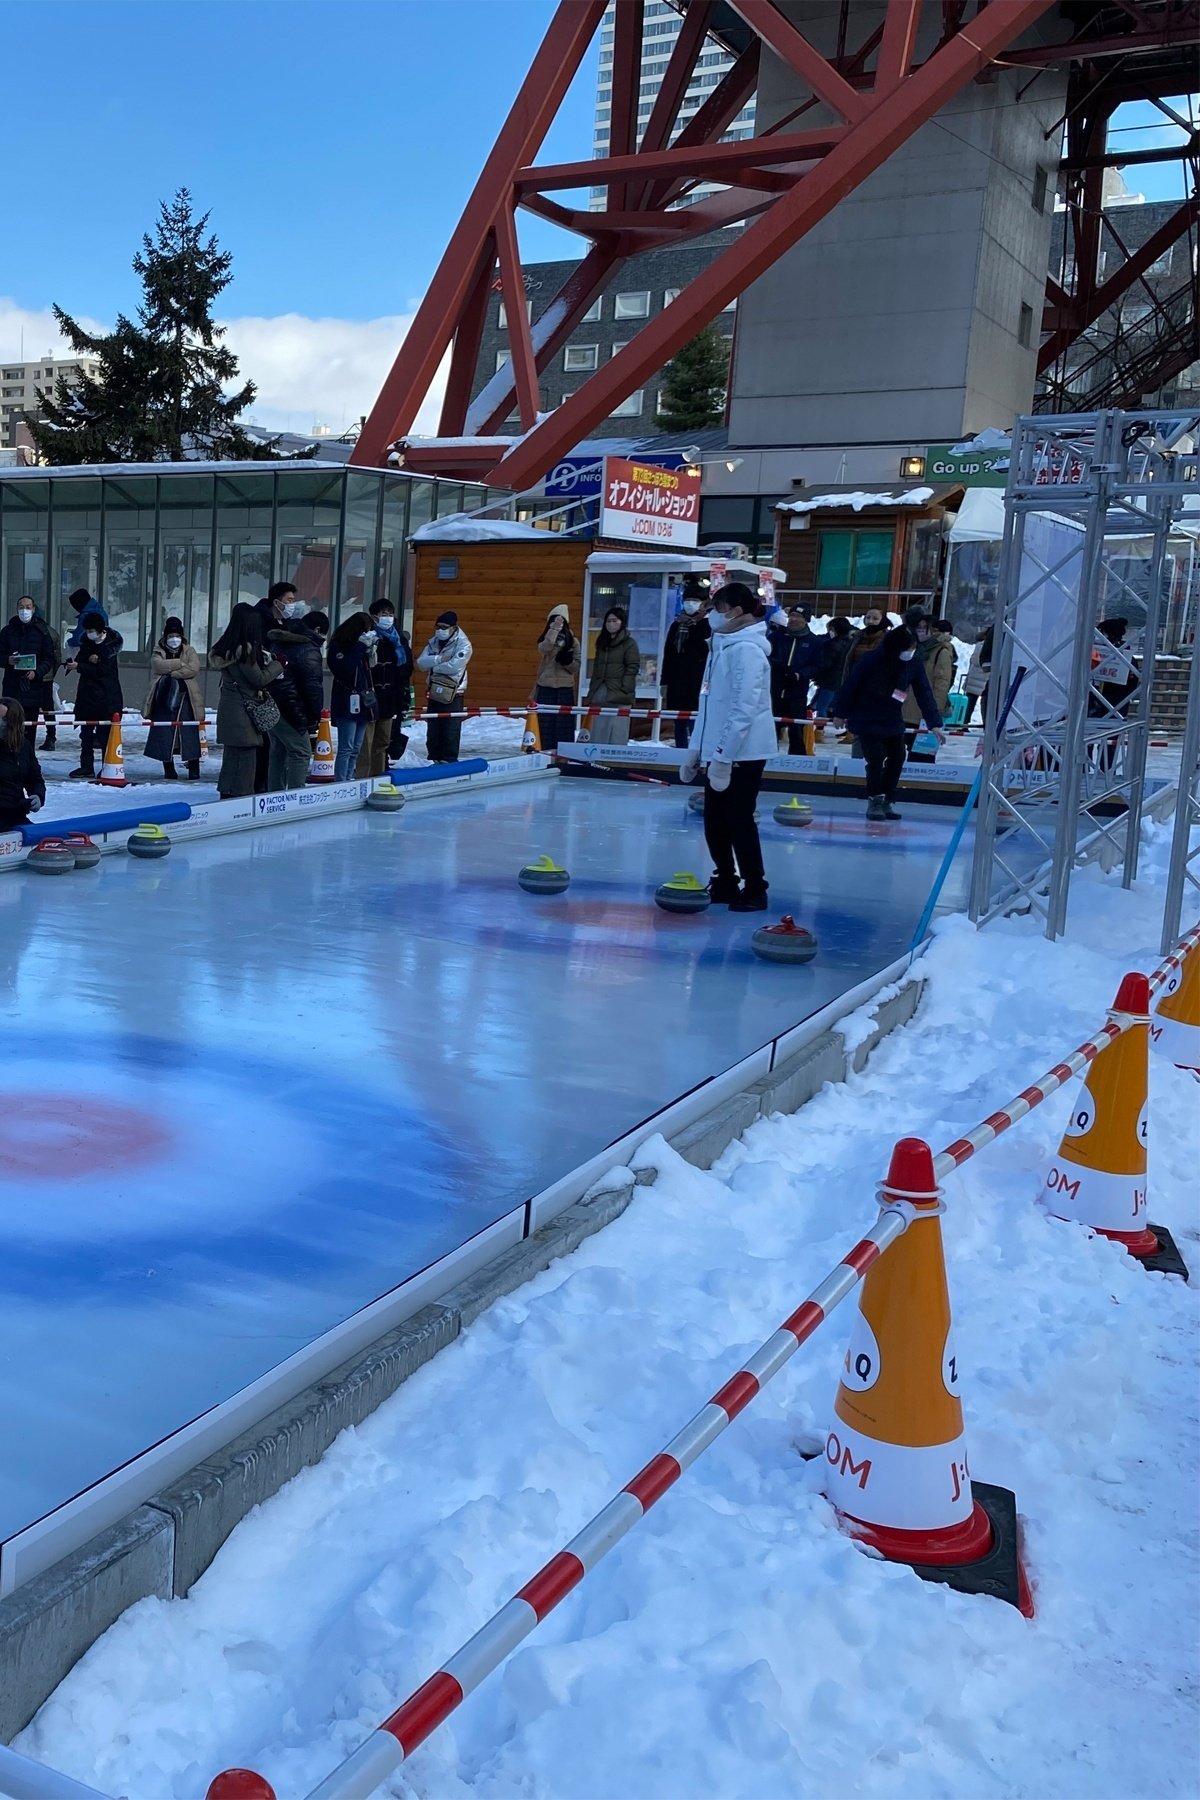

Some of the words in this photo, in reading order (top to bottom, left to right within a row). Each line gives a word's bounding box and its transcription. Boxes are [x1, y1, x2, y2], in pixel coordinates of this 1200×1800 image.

[932, 461, 955, 474] Go
[959, 463, 980, 476] up
[266, 794, 285, 804] FACTOR
[285, 793, 298, 801] NINE
[266, 804, 286, 813] SERVICE
